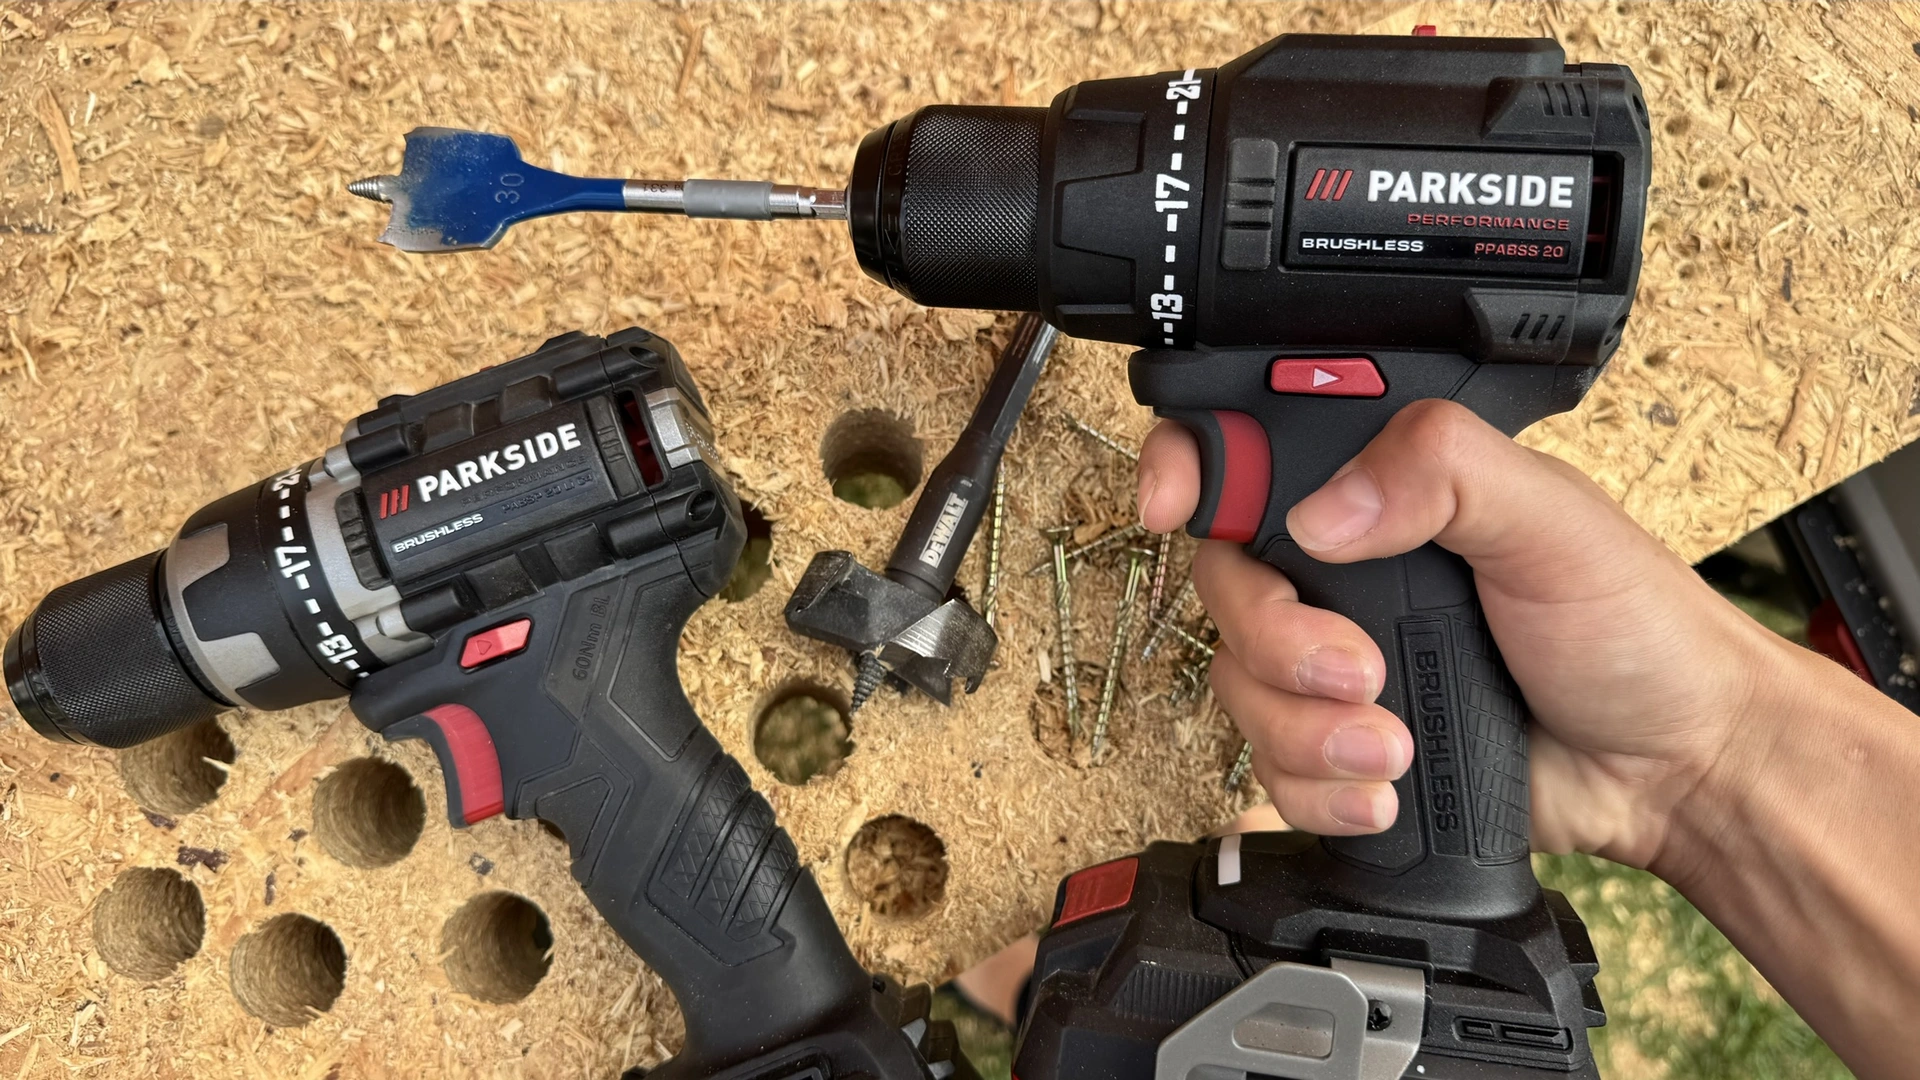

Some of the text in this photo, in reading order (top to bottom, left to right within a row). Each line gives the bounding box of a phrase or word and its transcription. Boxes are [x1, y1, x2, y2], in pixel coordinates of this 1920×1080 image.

[494, 173, 525, 204] 30
[1155, 173, 1190, 213] 17
[1367, 170, 1575, 208] PARKSIDE
[1407, 213, 1570, 231] PERFORMANCE
[1302, 238, 1425, 252] BRUSHLESS
[1543, 245, 1565, 258] 20
[1151, 293, 1183, 320] 13
[417, 423, 581, 503] PARKSIDE
[394, 513, 484, 553] BRUSHLESS
[919, 491, 969, 569] DEWALT
[275, 546, 311, 578] 17
[317, 634, 358, 664] 13
[572, 622, 602, 680] 60Nm
[1415, 650, 1458, 833] BRUSHLESS
